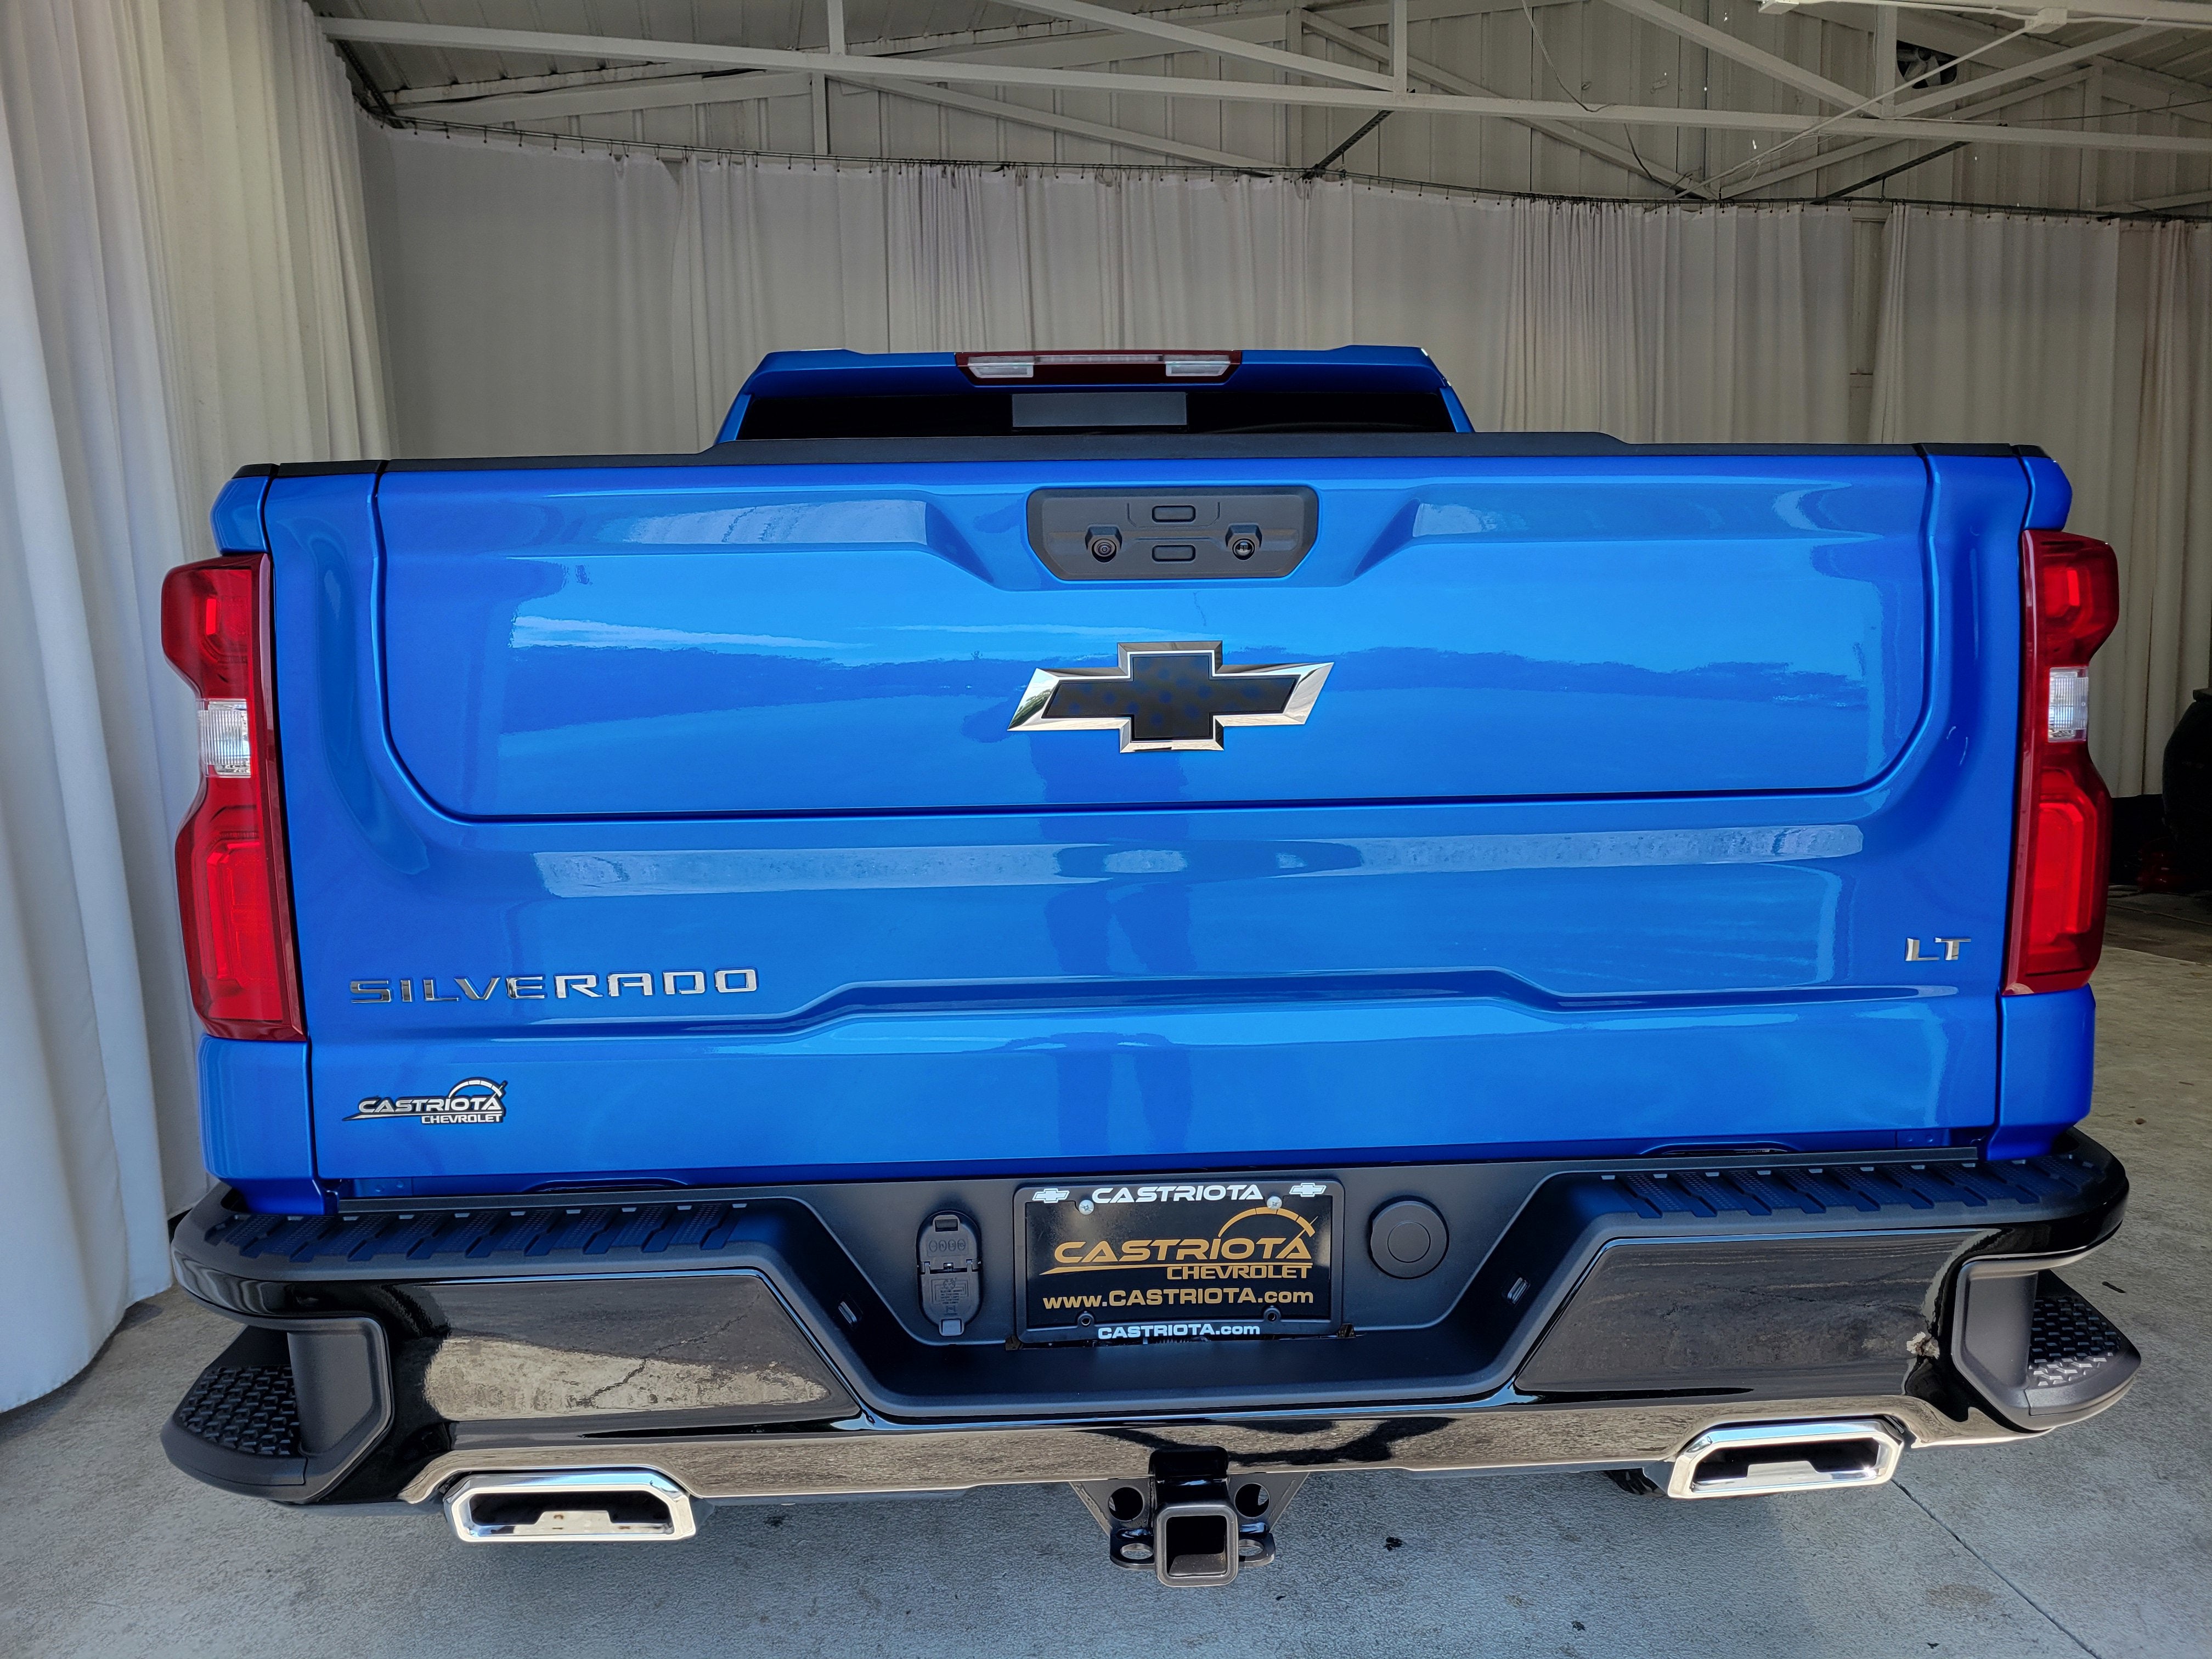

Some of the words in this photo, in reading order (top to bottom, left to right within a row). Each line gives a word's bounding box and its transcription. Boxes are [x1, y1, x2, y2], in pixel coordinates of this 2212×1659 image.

[1905, 937, 1972, 961] LT
[349, 967, 758, 1003] SILVERADO
[358, 1098, 501, 1113] CASTRIOTA
[421, 1114, 502, 1124] CHEVROLET
[1092, 1184, 1264, 1204] CASTRIOTA
[1054, 1237, 1313, 1262] CASTRIOTA
[1166, 1265, 1312, 1280] CHEVROLET
[1043, 1288, 1314, 1310] www.CASTRIOTA.com
[1098, 1323, 1261, 1340] CASTRIOTA.com
